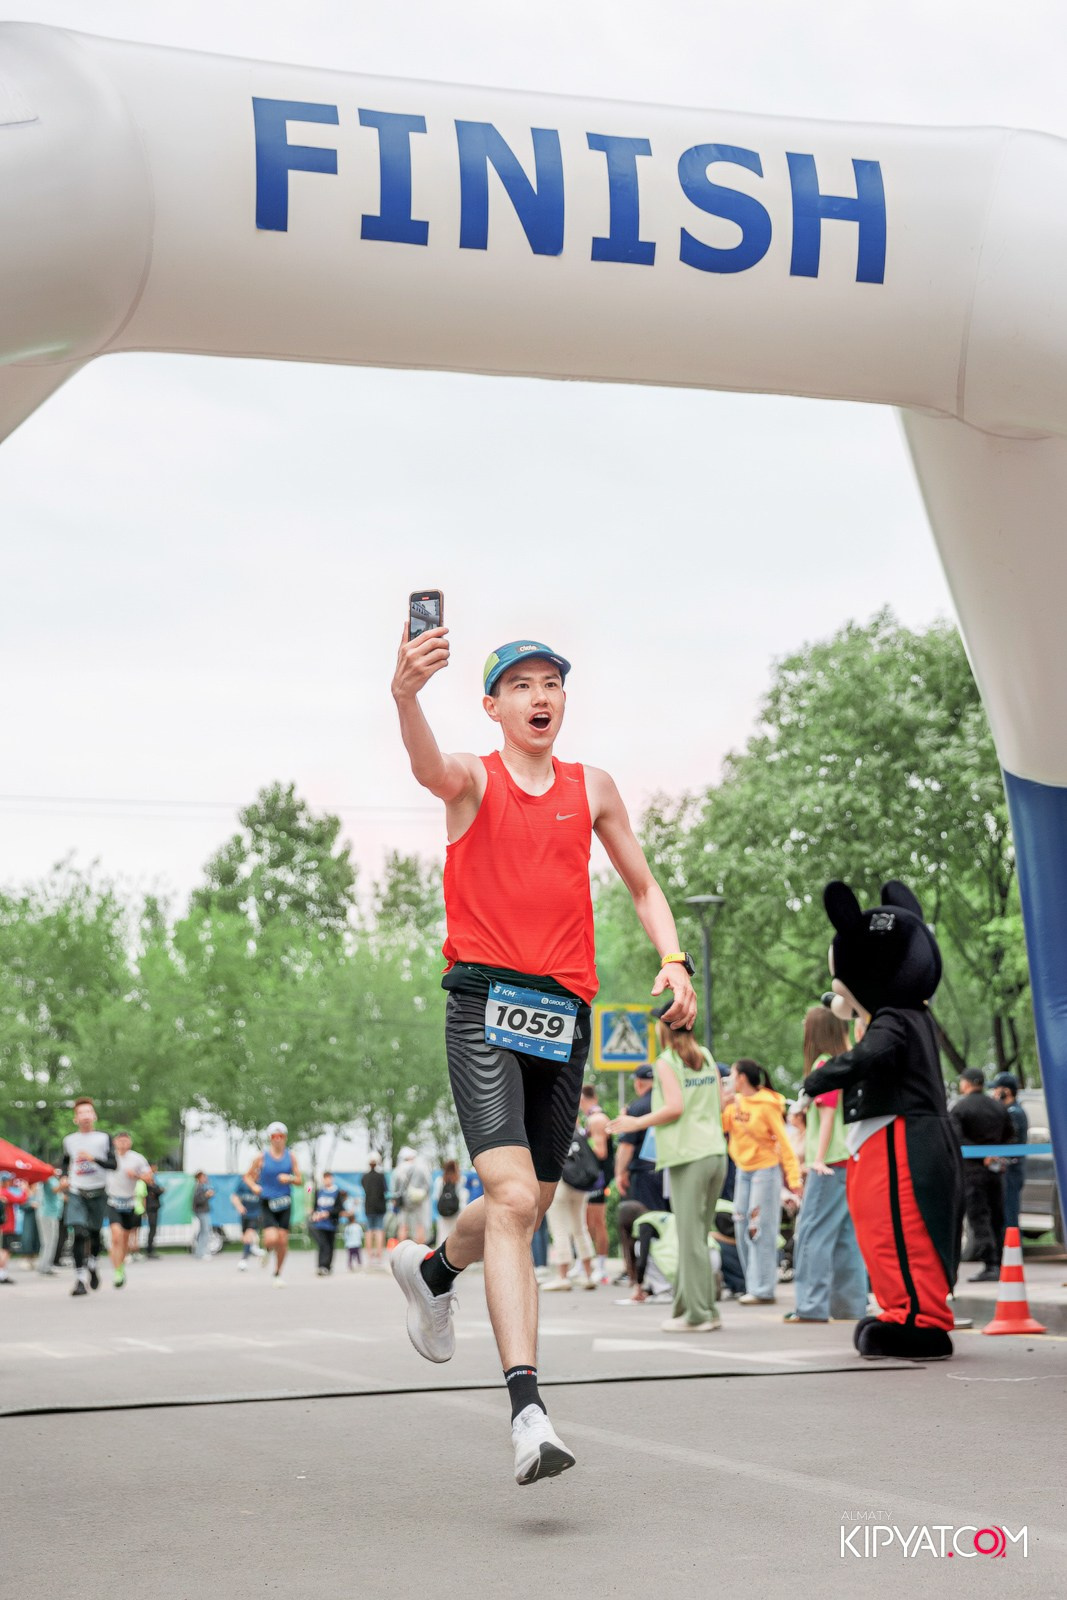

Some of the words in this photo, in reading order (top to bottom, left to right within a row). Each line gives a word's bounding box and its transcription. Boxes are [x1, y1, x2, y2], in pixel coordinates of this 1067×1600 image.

[252, 96, 886, 284] FINISH
[493, 985, 501, 993] 5
[502, 989, 516, 997] KM
[549, 999, 566, 1007] GROUP
[496, 1006, 565, 1038] 1059
